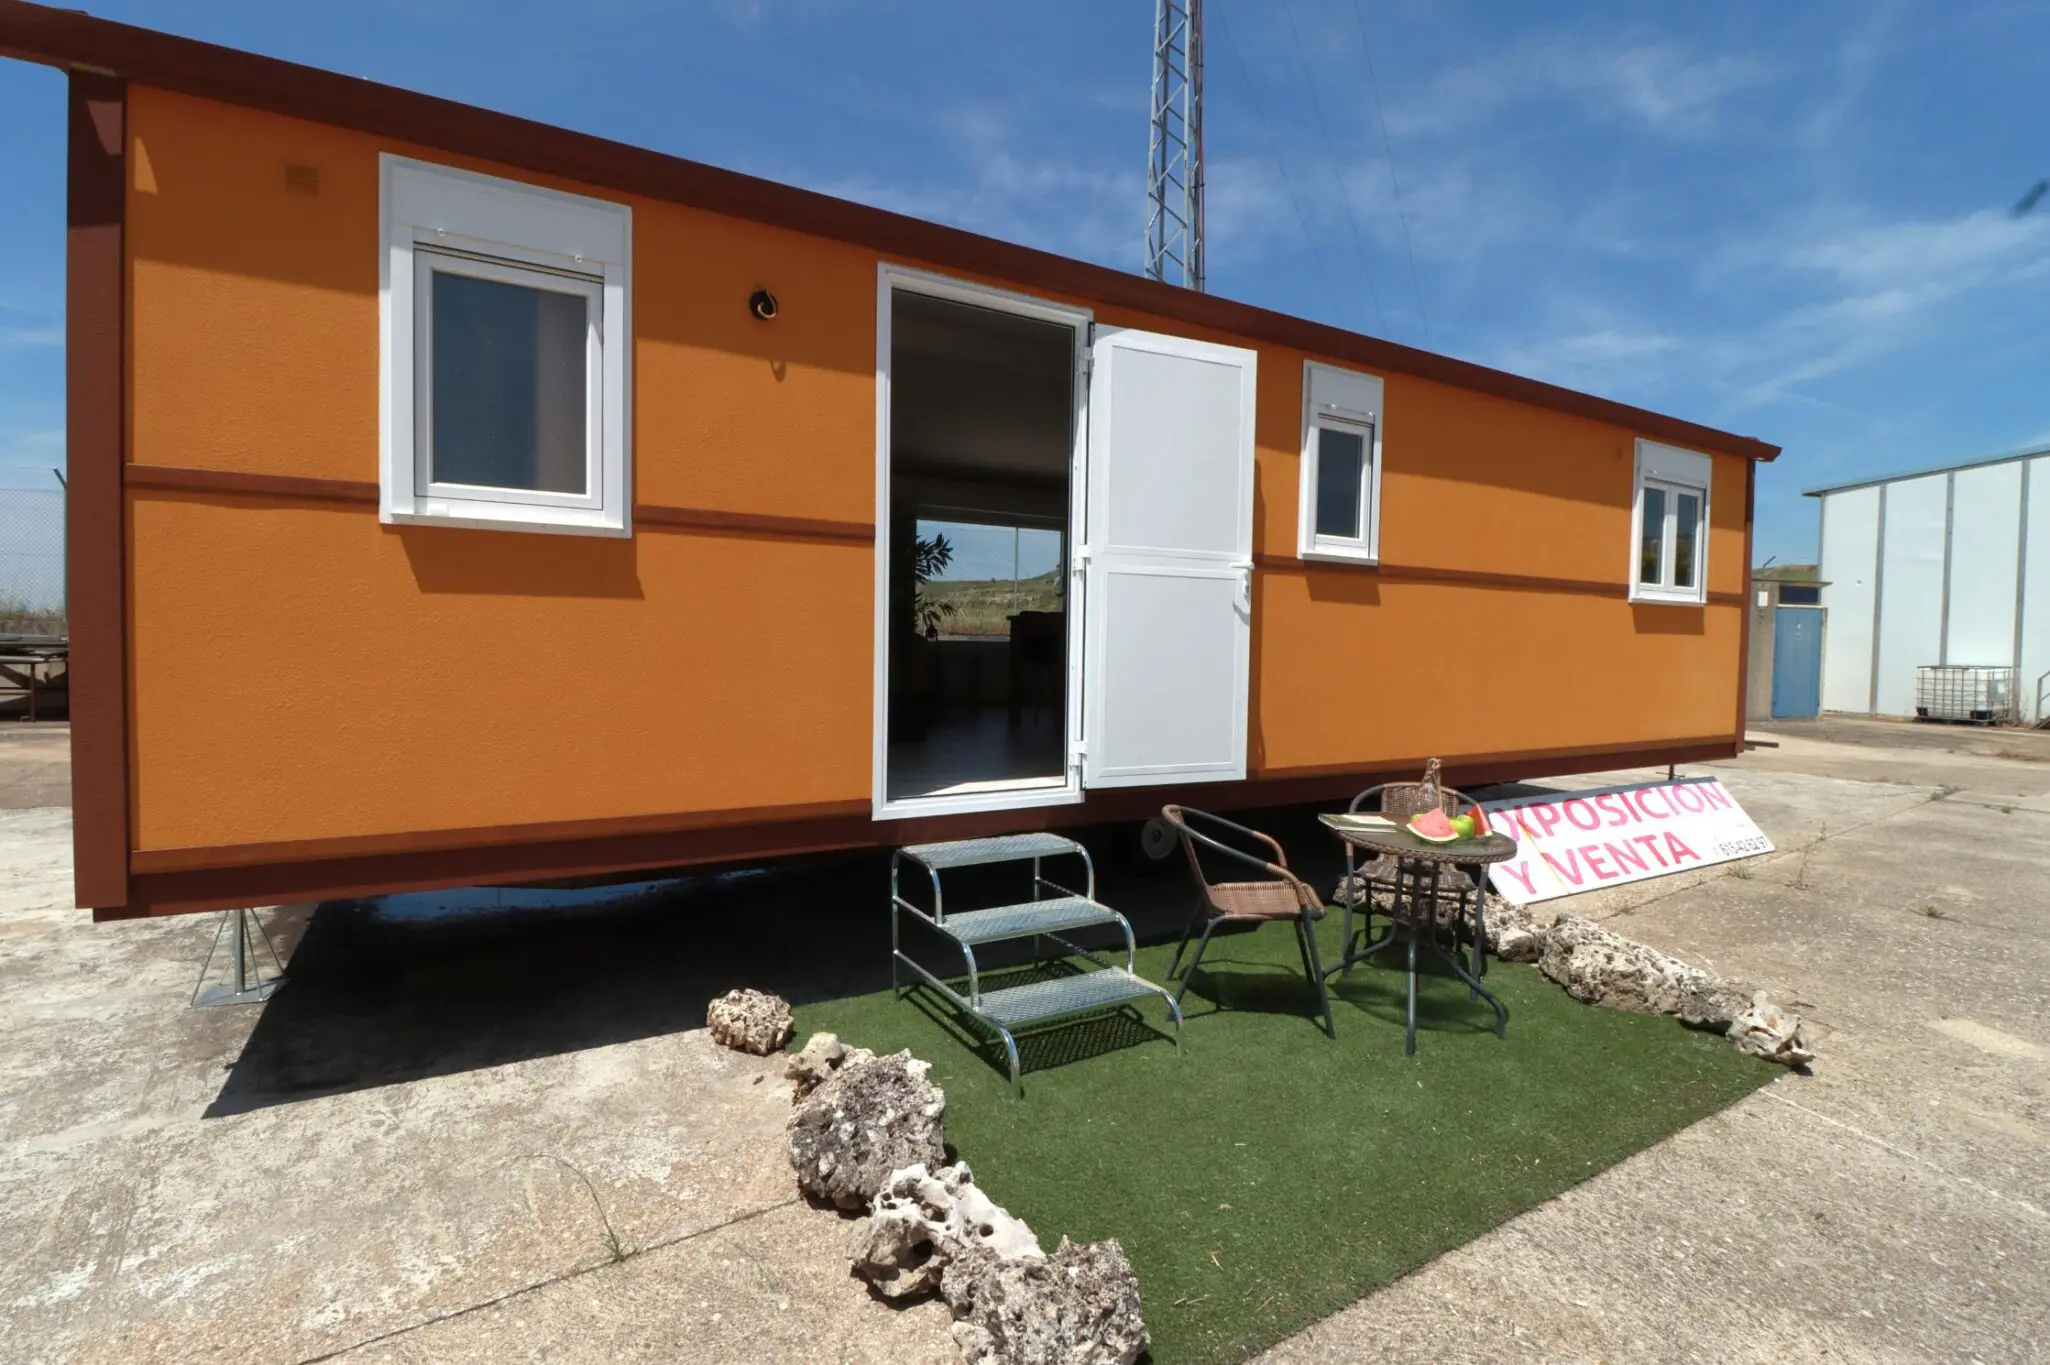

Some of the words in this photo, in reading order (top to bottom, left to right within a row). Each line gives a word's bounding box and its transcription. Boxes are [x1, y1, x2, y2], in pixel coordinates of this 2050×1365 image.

[1487, 782, 1732, 842] XPOSICION
[1500, 860, 1537, 895] Y
[1540, 831, 1701, 886] VENTA
